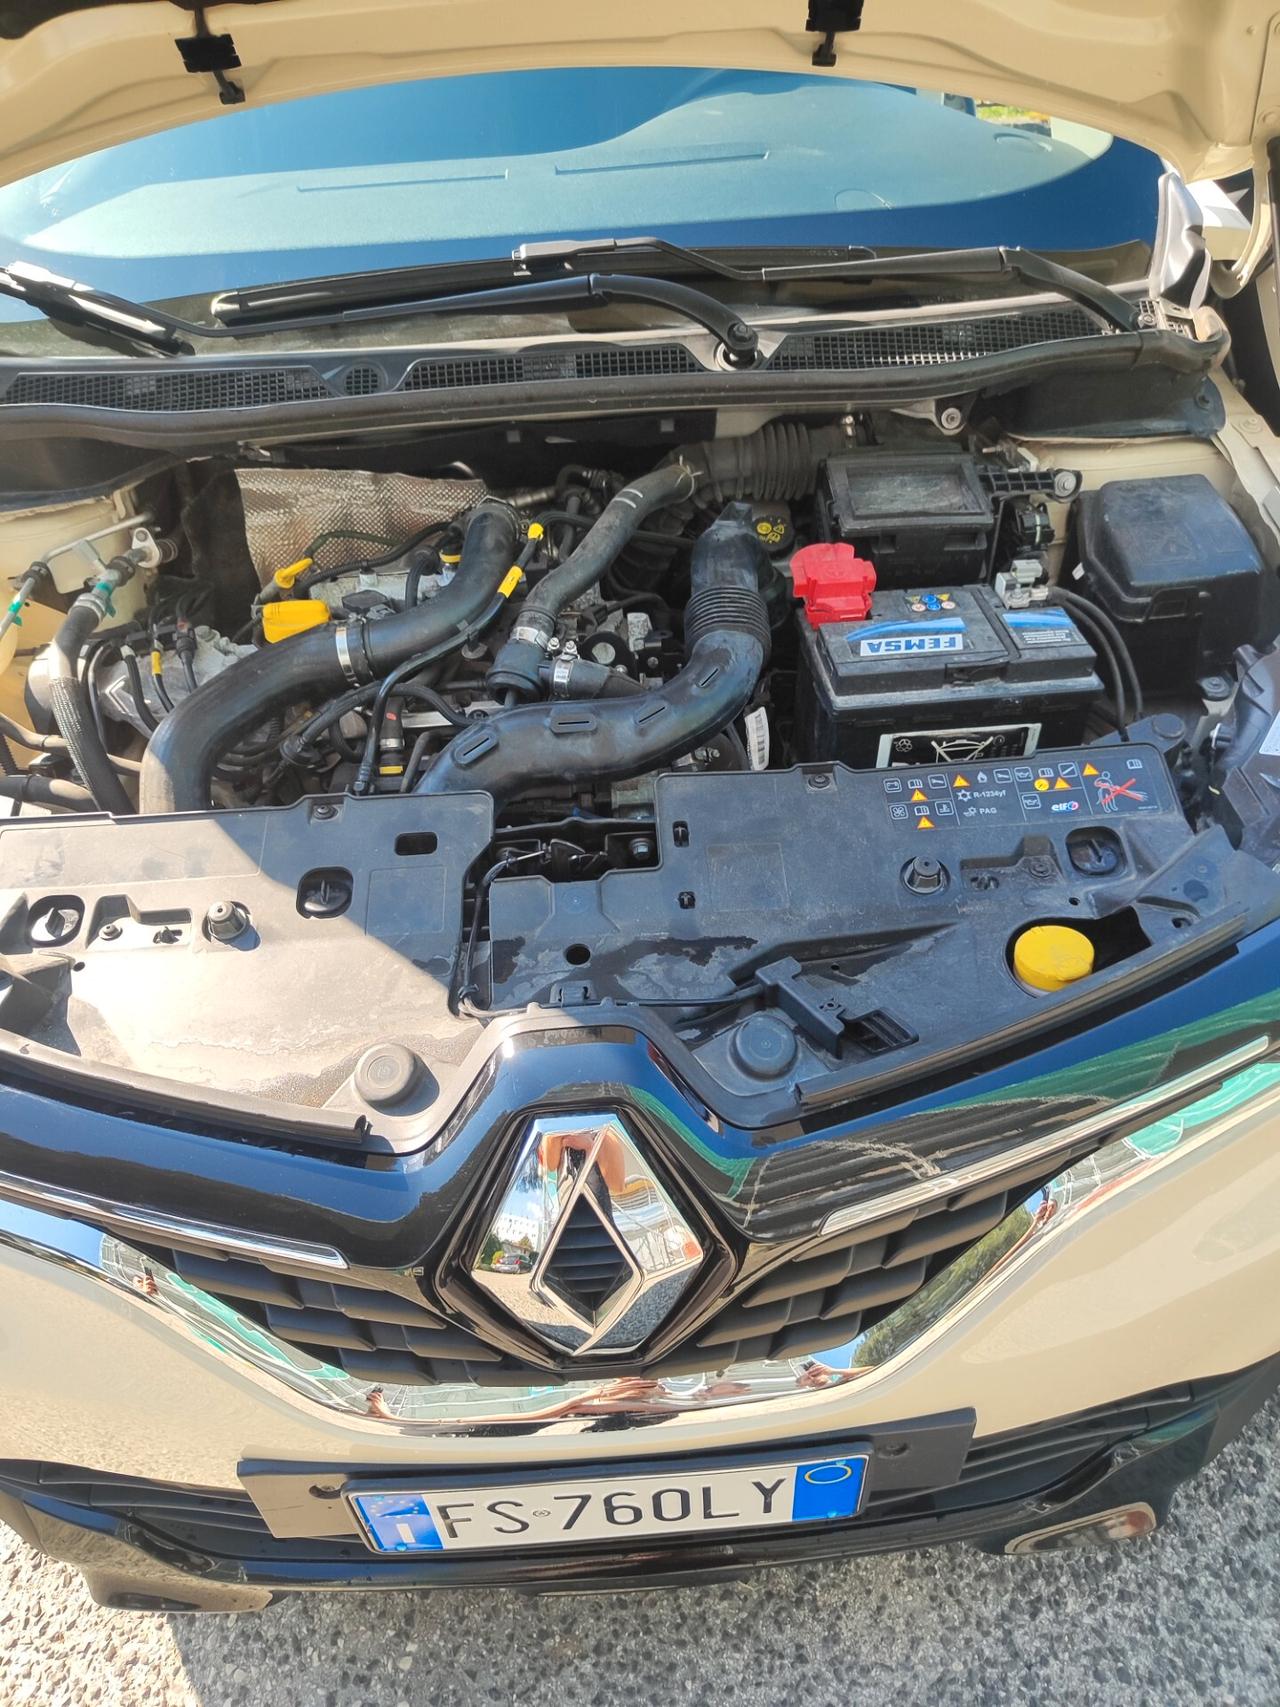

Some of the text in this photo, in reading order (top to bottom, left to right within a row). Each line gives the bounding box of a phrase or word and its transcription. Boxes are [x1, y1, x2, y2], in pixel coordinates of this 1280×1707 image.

[866, 636, 957, 654] FEMSA
[979, 807, 998, 815] PAG
[436, 1500, 530, 1539] FS
